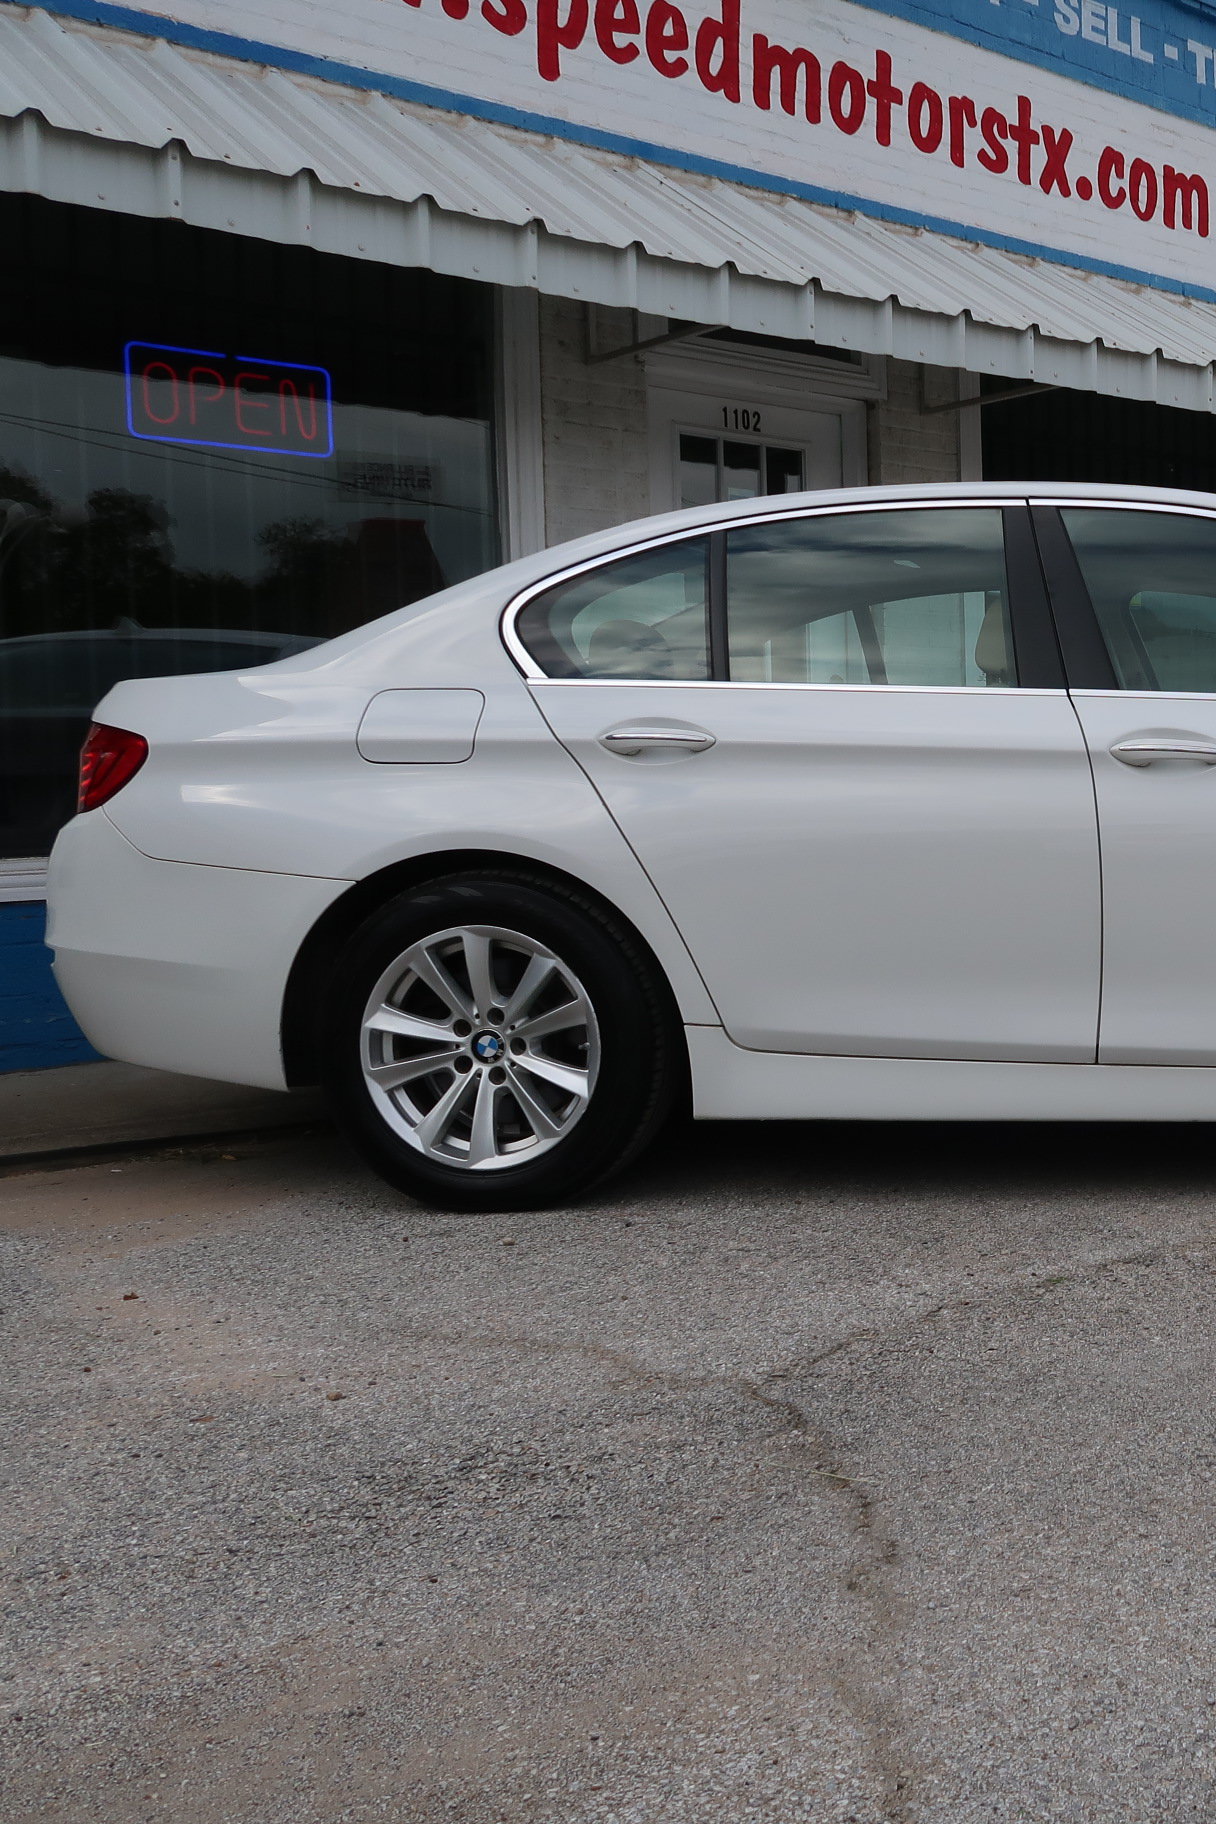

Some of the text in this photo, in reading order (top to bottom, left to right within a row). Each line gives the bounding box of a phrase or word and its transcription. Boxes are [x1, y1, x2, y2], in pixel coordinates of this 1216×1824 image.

[1053, 0, 1154, 64] SELL
[142, 361, 317, 441] OPEN
[722, 406, 762, 433] 1102
